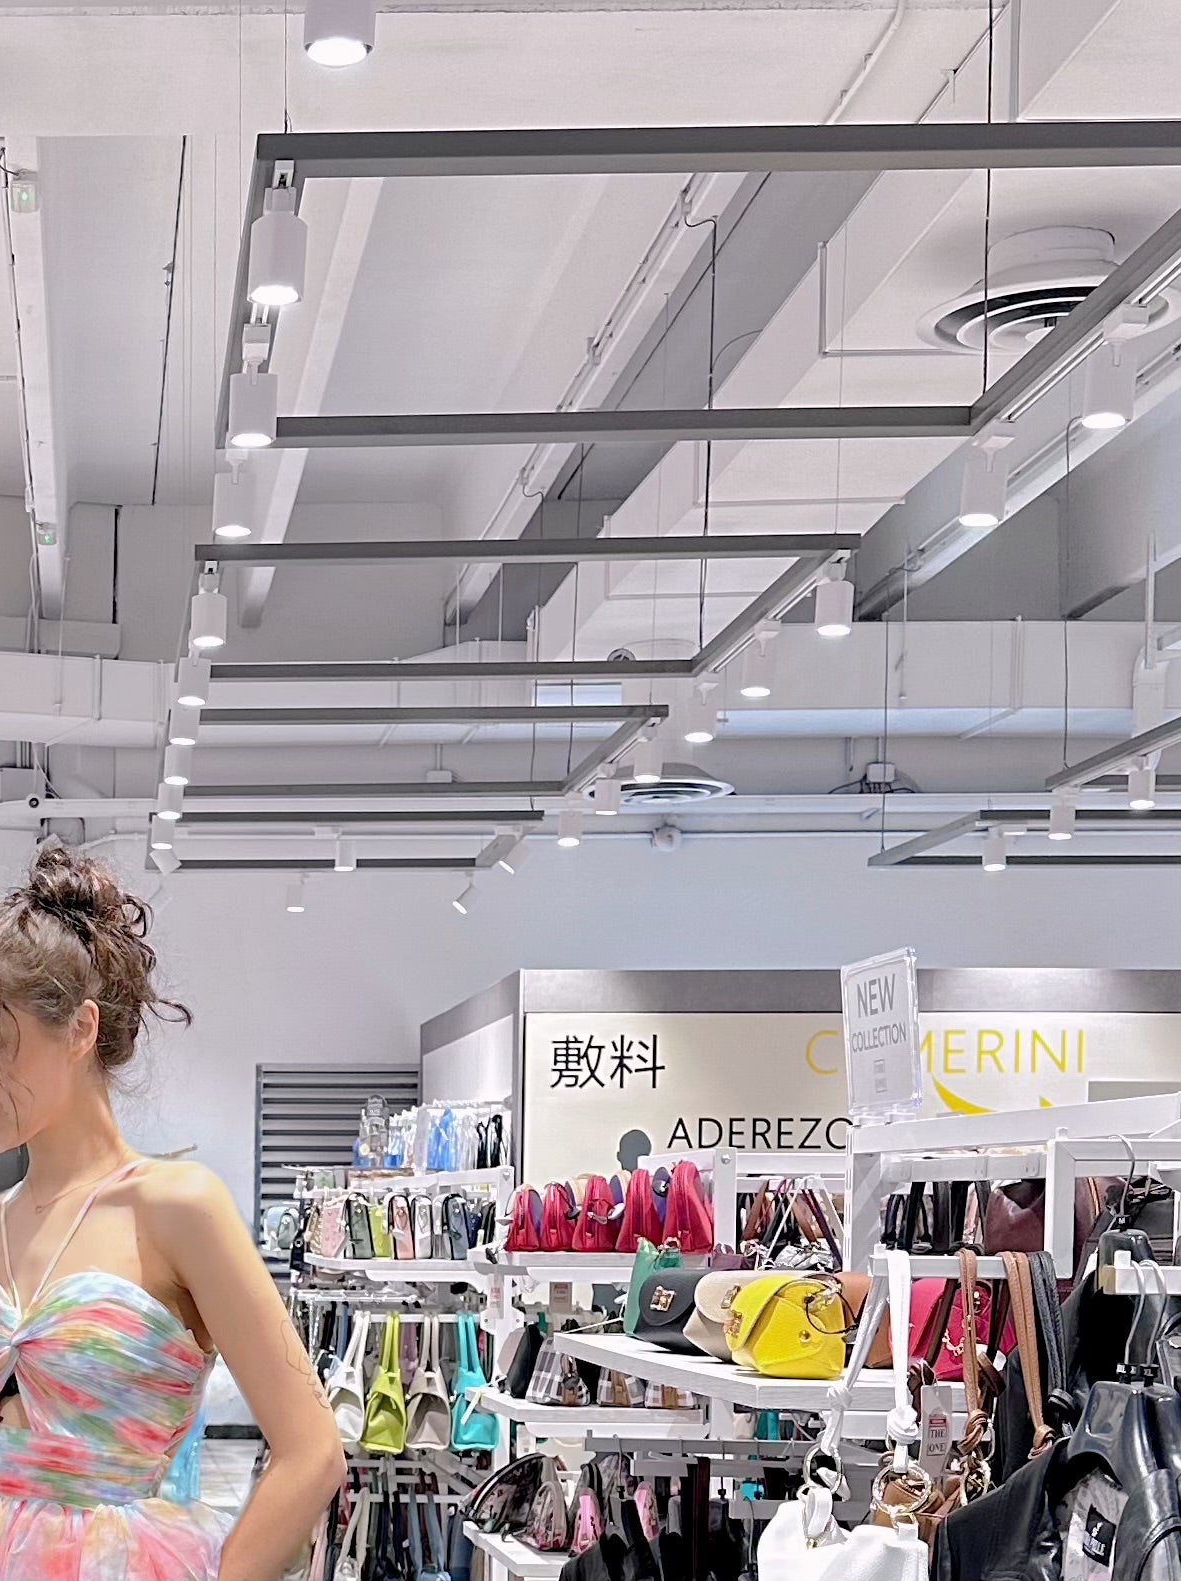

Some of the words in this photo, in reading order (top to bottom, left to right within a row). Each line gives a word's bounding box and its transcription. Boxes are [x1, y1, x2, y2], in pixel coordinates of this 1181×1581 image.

[856, 973, 896, 1018] NEW
[805, 1029, 1085, 1075] CERINI
[851, 1021, 907, 1053] COLLECTION
[550, 1034, 666, 1089] 敷料
[930, 1429, 945, 1439] THE
